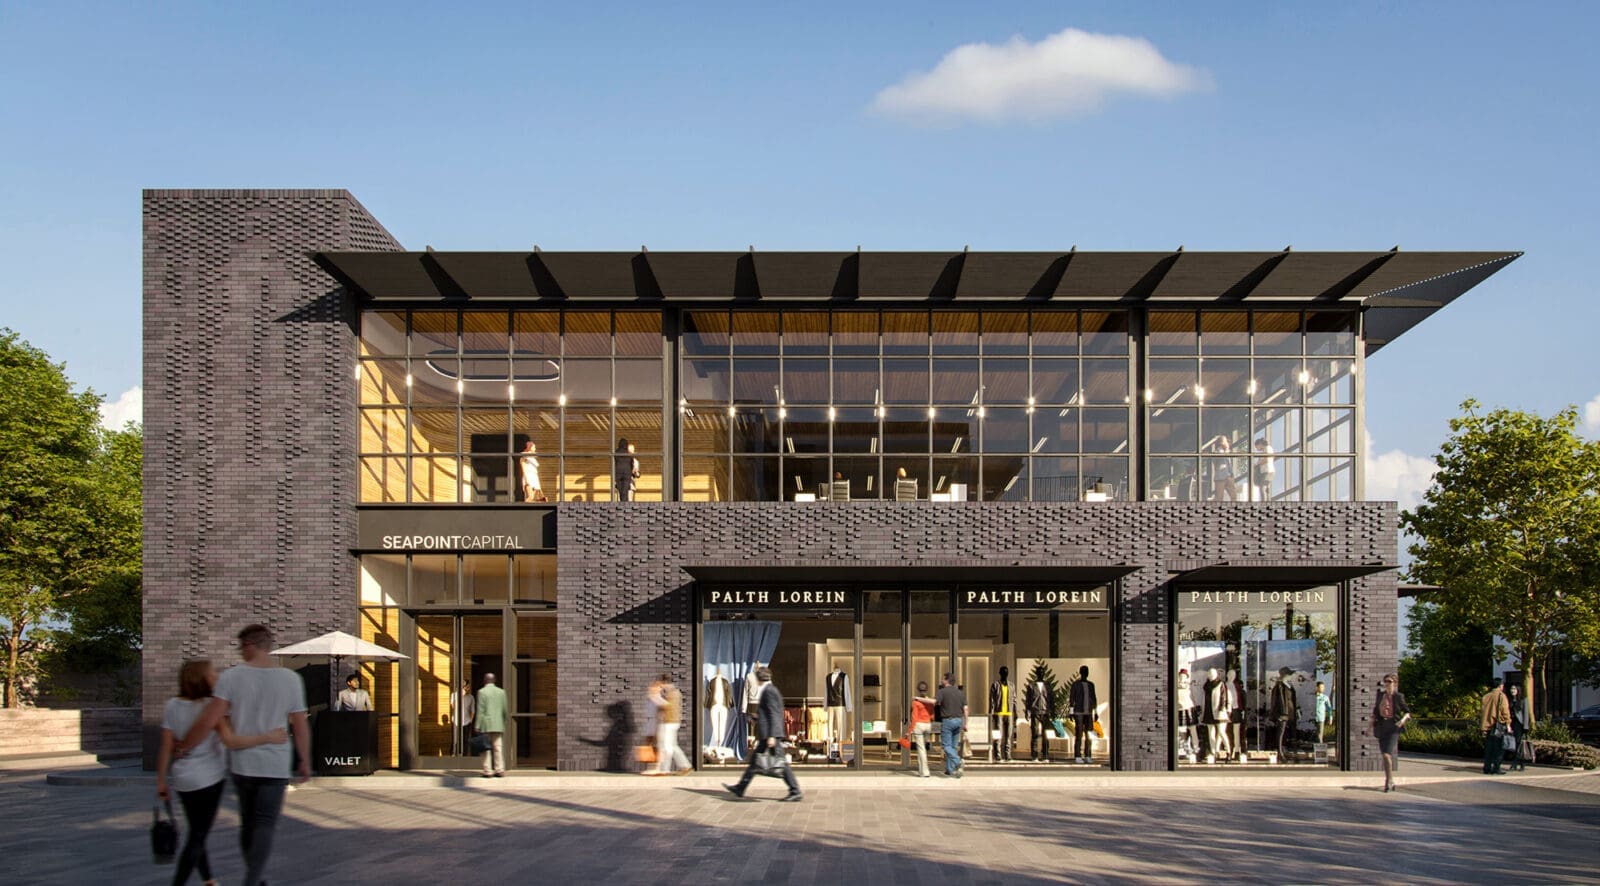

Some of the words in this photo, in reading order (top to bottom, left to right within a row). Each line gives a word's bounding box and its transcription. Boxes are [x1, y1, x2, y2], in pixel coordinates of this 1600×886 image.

[711, 591, 769, 603] PALTH
[779, 591, 845, 603] LOREIN
[967, 591, 1025, 603] PALTH
[1035, 591, 1101, 603] LOREIN
[1191, 591, 1249, 603] PALTH
[1260, 591, 1325, 603] LOREIN
[324, 756, 361, 766] VALET
